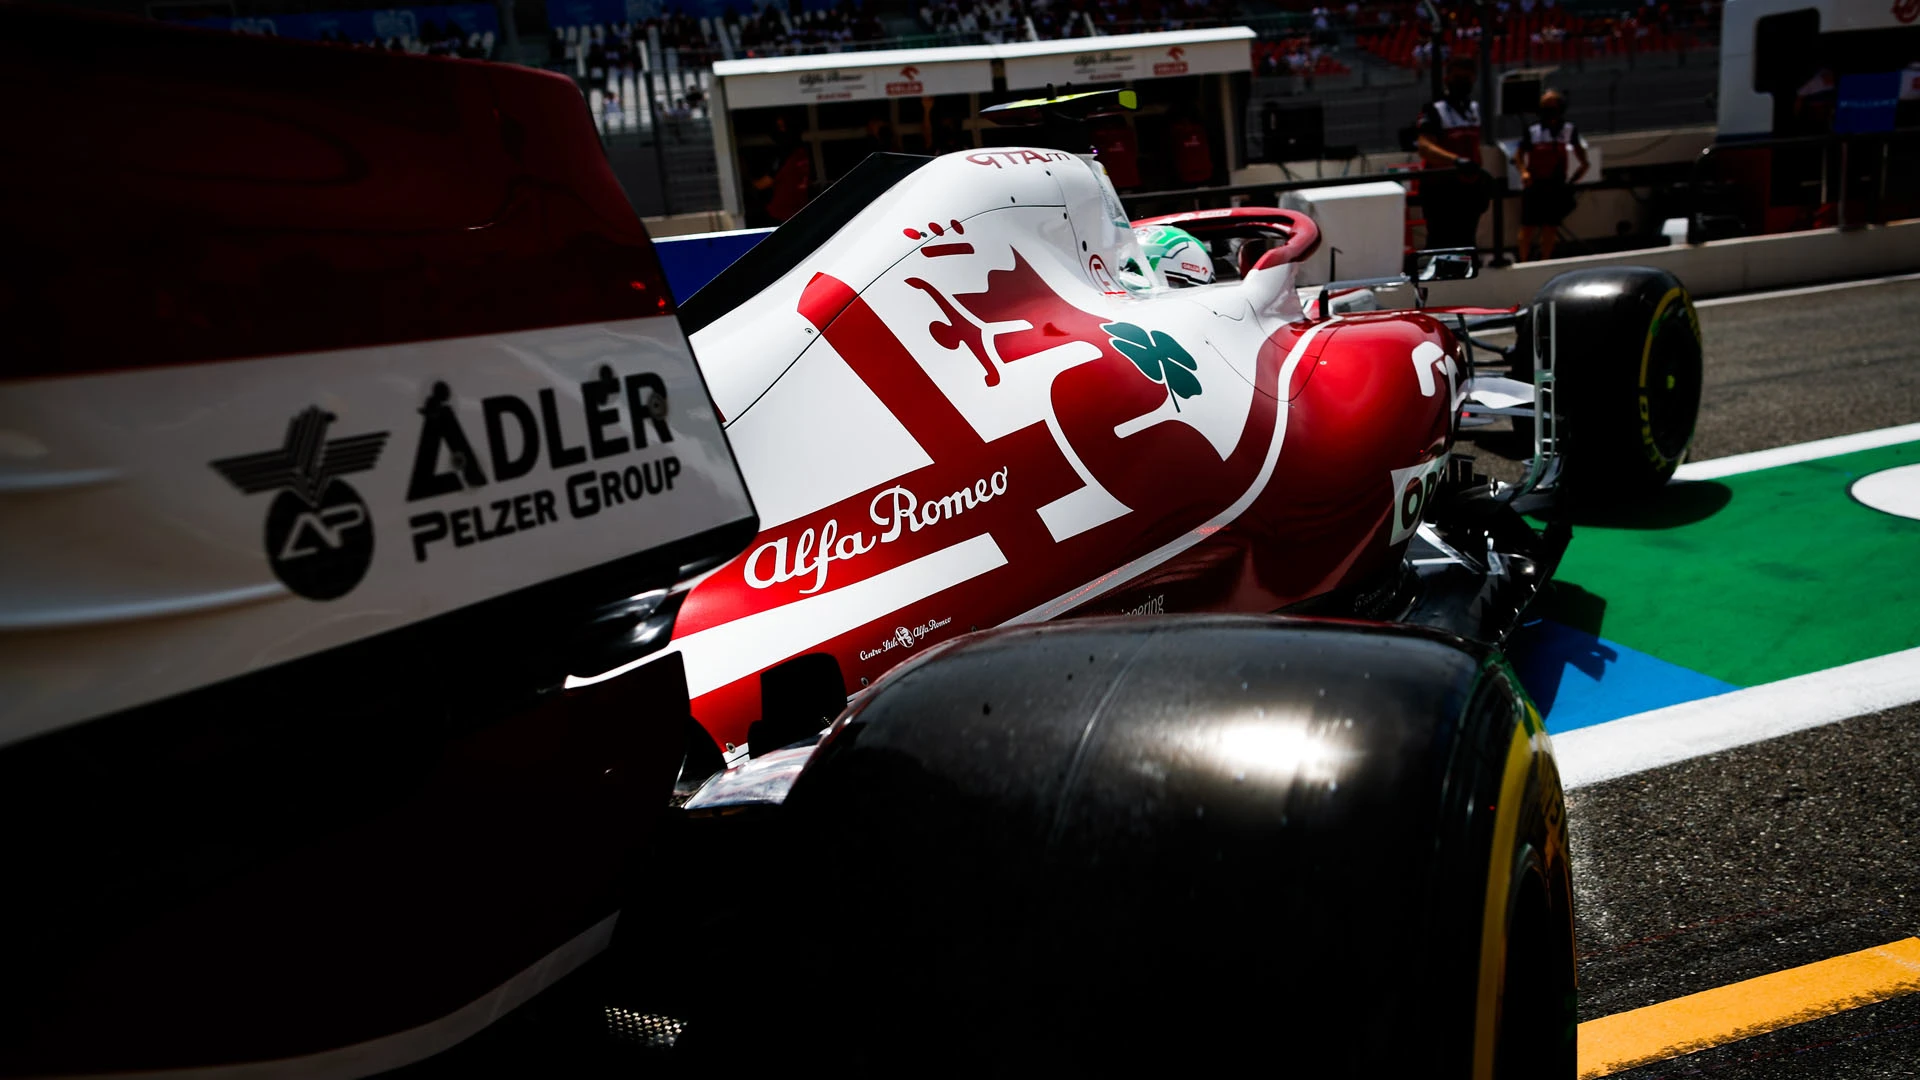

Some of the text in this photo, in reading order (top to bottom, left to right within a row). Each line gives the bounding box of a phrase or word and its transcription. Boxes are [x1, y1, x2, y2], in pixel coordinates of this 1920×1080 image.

[407, 365, 673, 500] ADLER
[411, 457, 681, 560] PELZER GROUP
[743, 465, 1009, 594] Alfa Romeo
[860, 647, 882, 661] Centro
[913, 625, 929, 640] Alfa
[928, 616, 952, 631] Romeo
